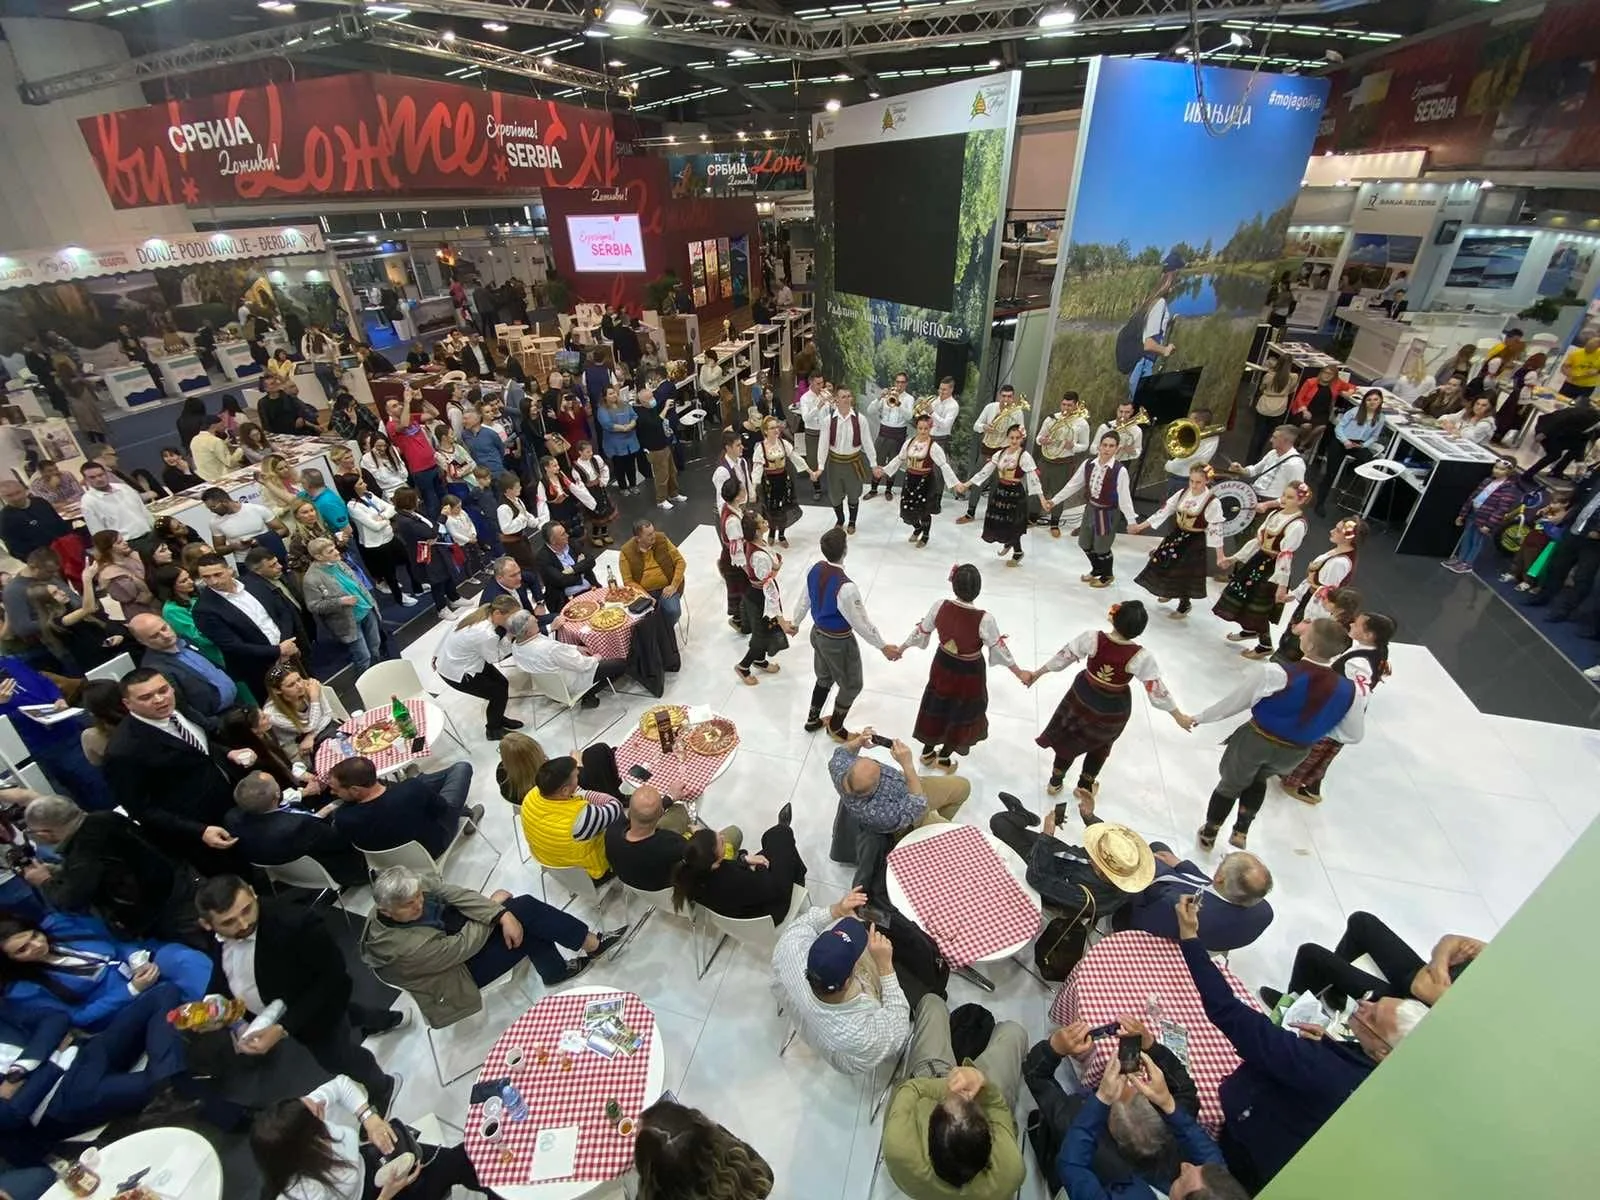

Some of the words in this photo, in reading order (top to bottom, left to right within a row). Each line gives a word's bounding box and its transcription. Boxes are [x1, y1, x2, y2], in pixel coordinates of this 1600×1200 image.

[1414, 96, 1458, 122] SERBIA
[168, 116, 254, 153] СРБИЈА
[486, 114, 538, 145] Experience!
[506, 142, 562, 169] SERBIA
[707, 163, 749, 176] СРБИЈА
[136, 244, 180, 264] DONJE
[181, 238, 251, 260] PODUNAVLJE
[591, 243, 633, 256] SERBIA
